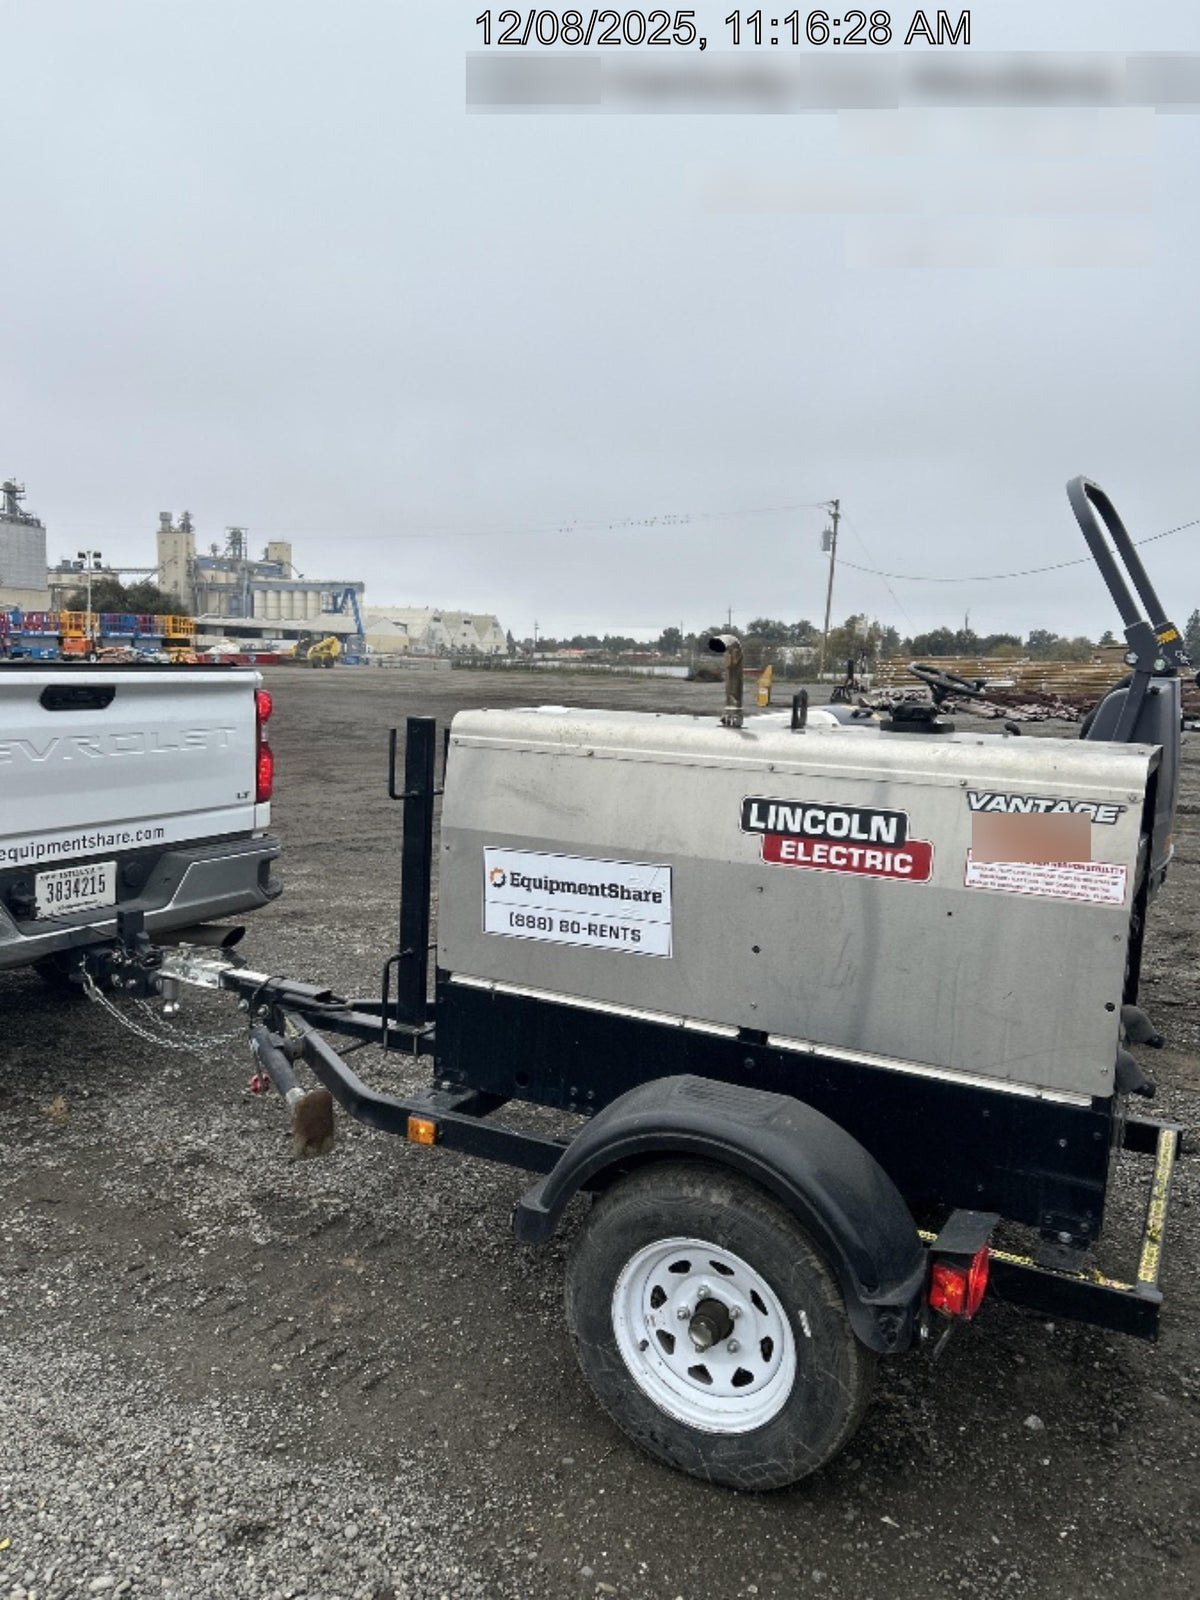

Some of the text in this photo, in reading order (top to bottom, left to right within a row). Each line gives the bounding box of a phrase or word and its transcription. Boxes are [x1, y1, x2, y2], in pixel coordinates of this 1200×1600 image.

[749, 802, 898, 844] LINCOLN
[0, 827, 165, 862] equipmentshare.com
[779, 839, 913, 874] ELECTRIC
[46, 873, 106, 904] 3834215
[510, 871, 663, 904] EquipmentShare
[509, 911, 554, 932] (888)
